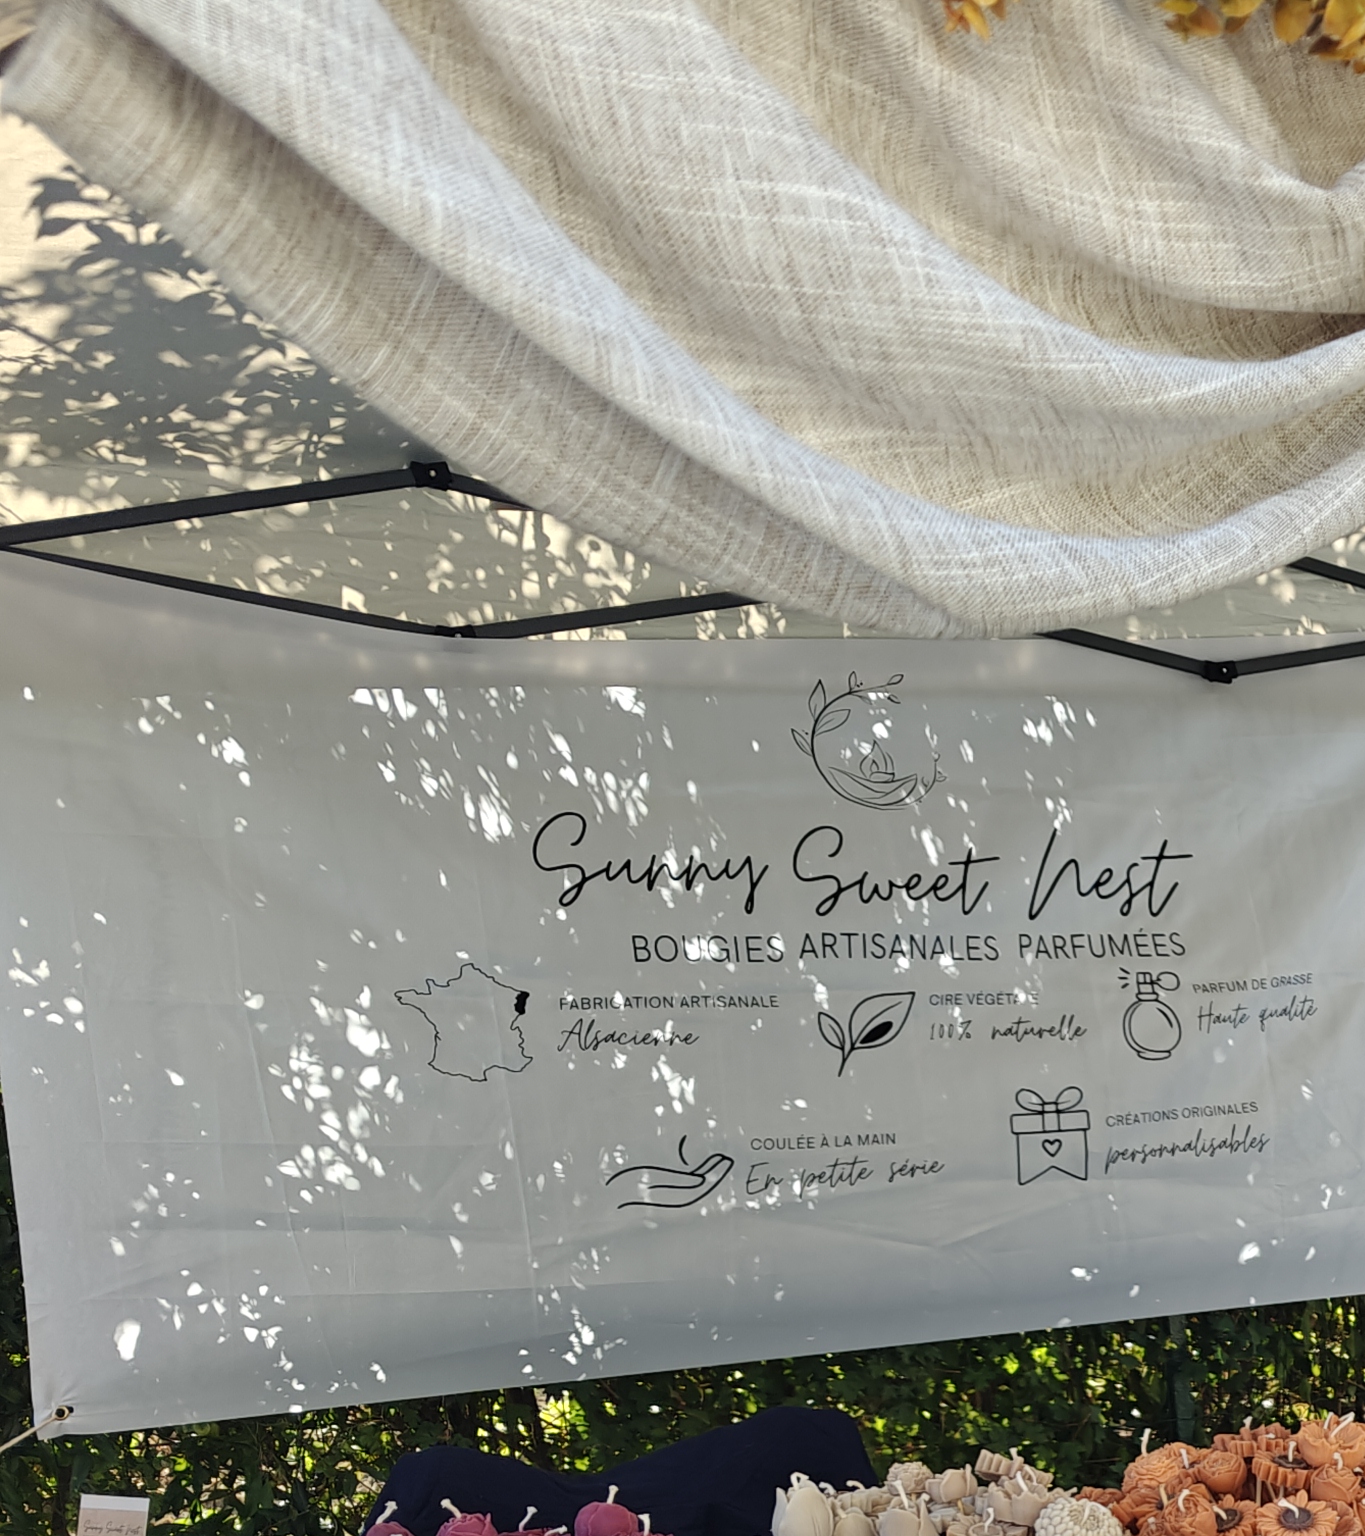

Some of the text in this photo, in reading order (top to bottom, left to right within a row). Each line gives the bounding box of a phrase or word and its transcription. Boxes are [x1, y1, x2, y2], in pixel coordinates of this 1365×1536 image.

[533, 812, 1193, 920] Sunny Sweet Nest
[631, 928, 1187, 963] BOUGIES ARTISANALES PARFUMÉES
[929, 990, 1039, 1006] CIRE VÉGÉTAE
[1192, 973, 1313, 994] PARFUM DE GRASSE
[559, 994, 780, 1011] FABRICATION ARTISANALE
[1197, 995, 1318, 1034] Haute qualité
[557, 1018, 700, 1052] Alsacienne
[929, 1014, 1087, 1043] 100% naturelle
[1105, 1101, 1259, 1127] CRÉATIONS ORIGINALES
[751, 1132, 897, 1151] COULÉE À LA MAIN
[1104, 1123, 1270, 1174] personnalisables
[746, 1156, 945, 1200] En petite série
